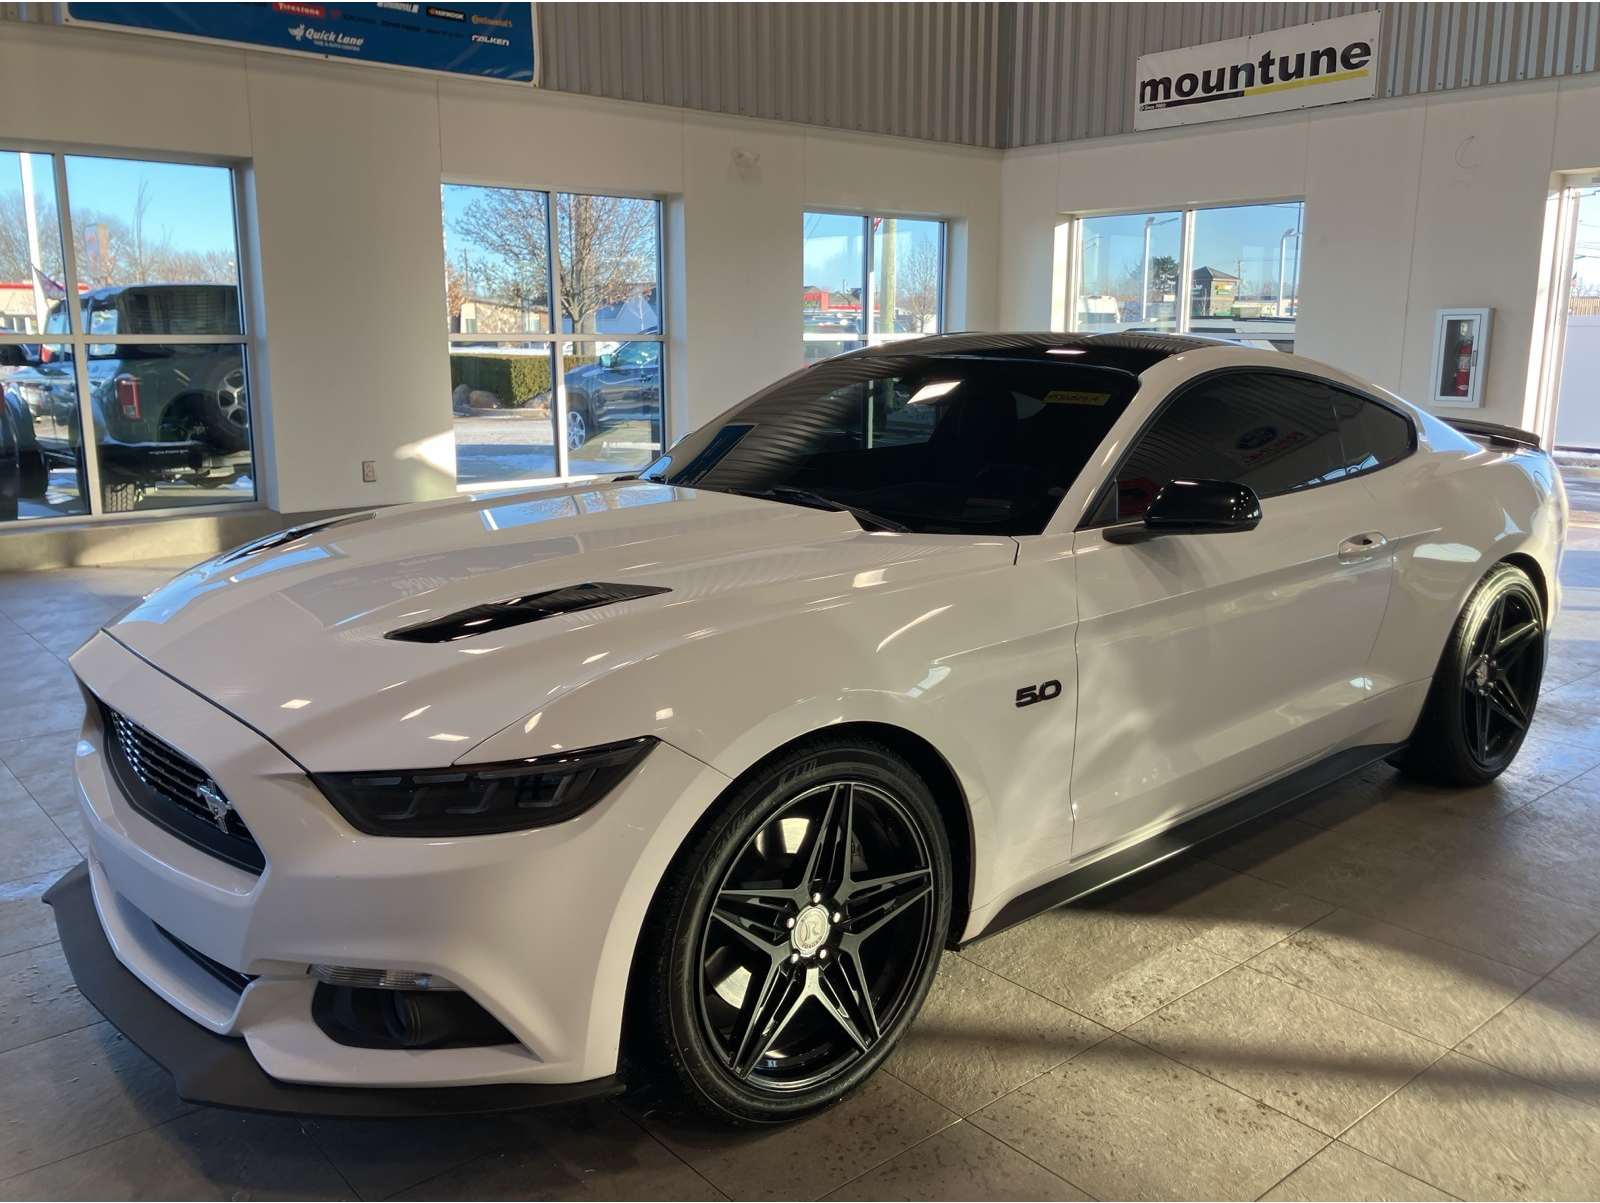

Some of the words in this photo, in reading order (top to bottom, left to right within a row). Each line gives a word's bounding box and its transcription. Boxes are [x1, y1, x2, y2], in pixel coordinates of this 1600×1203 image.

[305, 27, 335, 42] Quick
[336, 33, 365, 46] Lane
[1139, 41, 1372, 104] mountune
